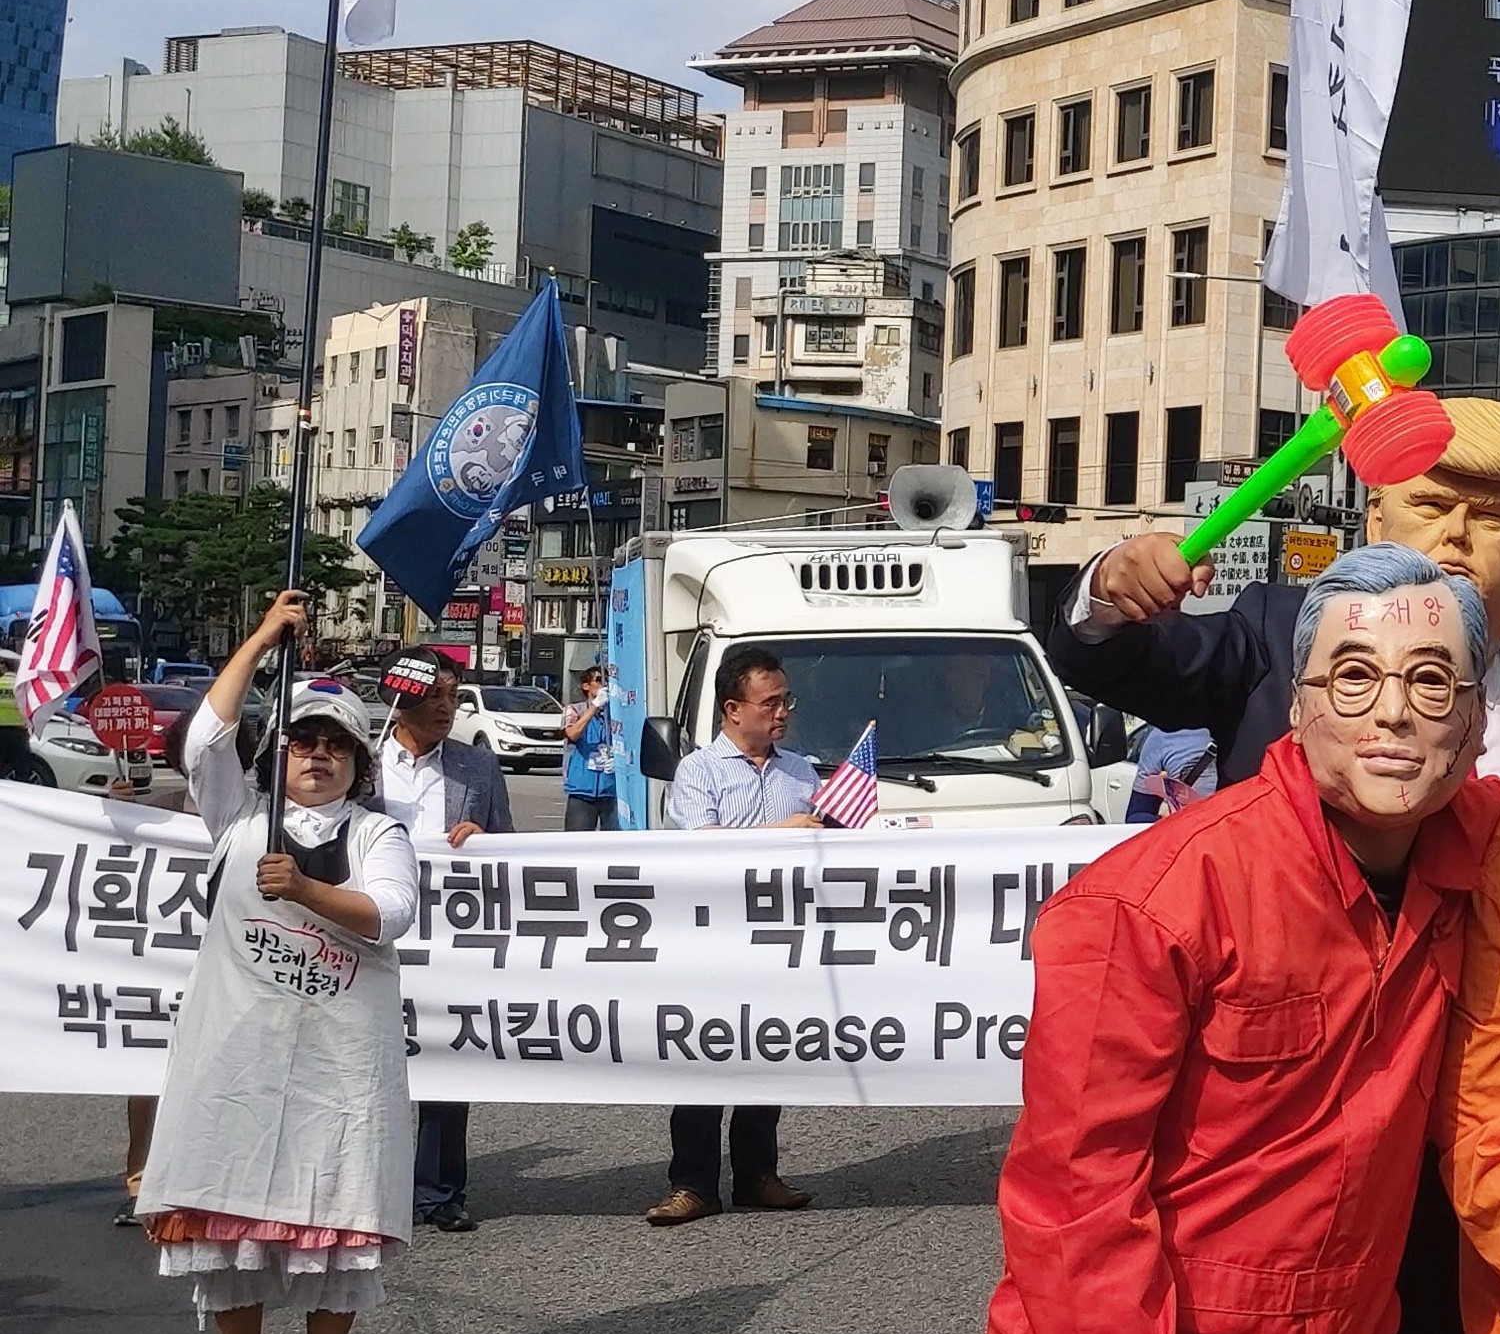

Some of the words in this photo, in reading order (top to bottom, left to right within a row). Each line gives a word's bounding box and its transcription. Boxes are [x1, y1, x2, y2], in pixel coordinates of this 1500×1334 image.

[592, 491, 613, 506] NAIL
[831, 553, 901, 563] HYUNDAI
[1344, 596, 1446, 632] 문재앙
[17, 842, 209, 957] 기획조
[744, 864, 957, 969] 박근혜
[243, 928, 307, 967] 박근혜
[273, 964, 342, 997] 대통령
[56, 982, 185, 1050] 박근
[447, 997, 624, 1065] 지킴이
[655, 1002, 906, 1064] Release
[934, 1001, 1026, 1062] Pre
